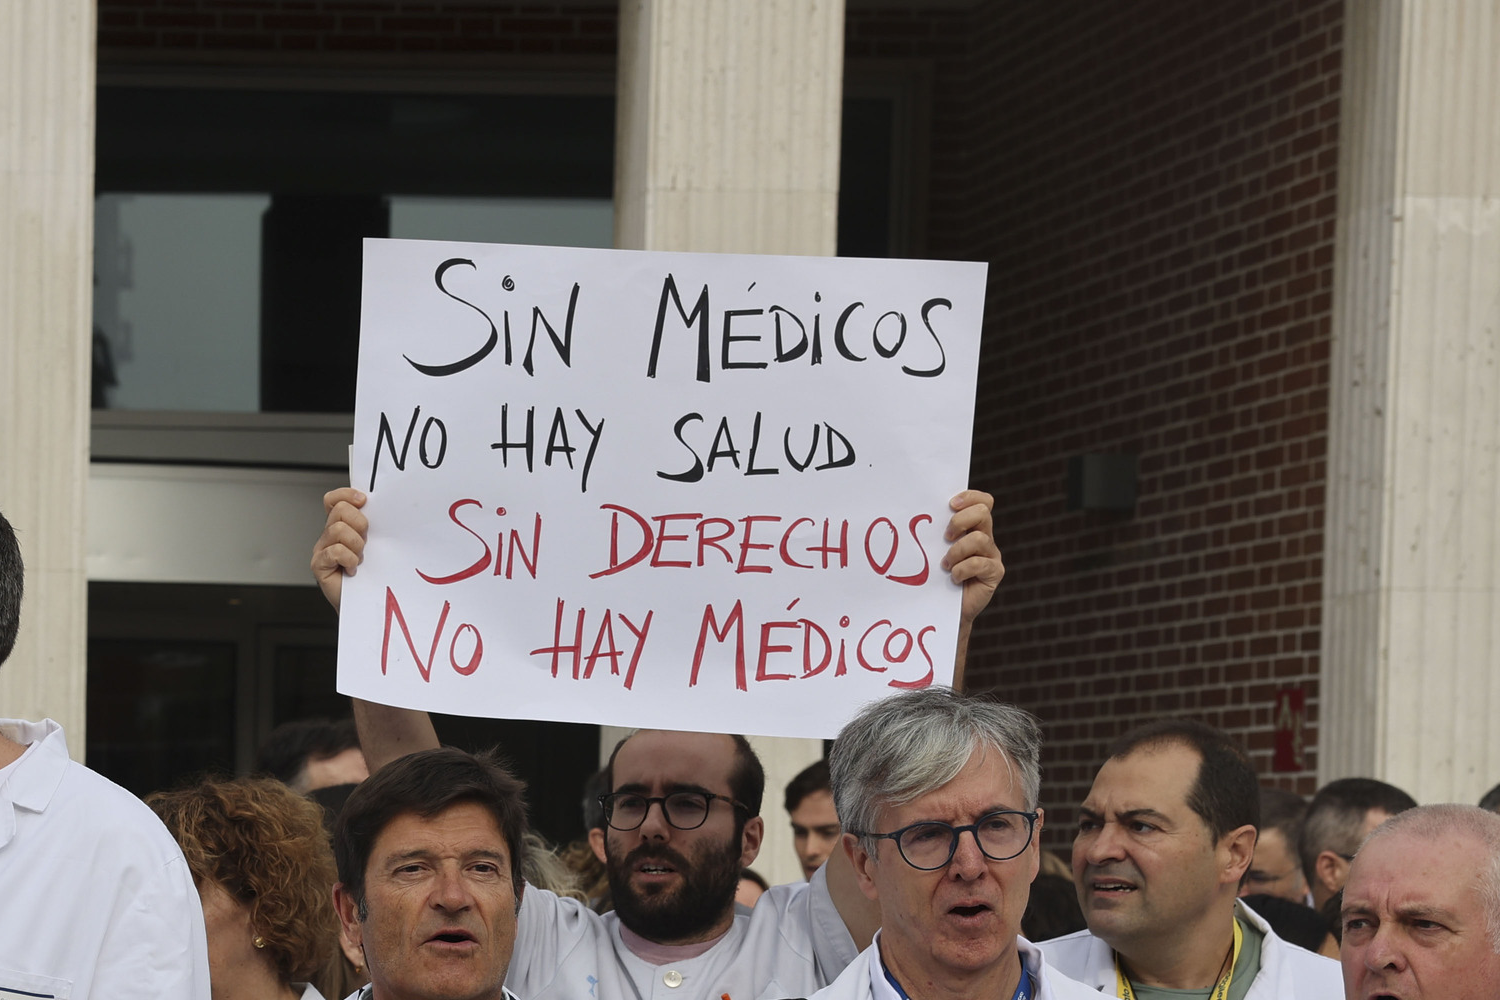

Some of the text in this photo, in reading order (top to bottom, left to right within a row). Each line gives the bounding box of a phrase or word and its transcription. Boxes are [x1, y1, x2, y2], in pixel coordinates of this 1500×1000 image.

[370, 406, 447, 492] NO
[491, 403, 604, 493] HAY
[590, 504, 932, 585] DERECHOS
[531, 599, 653, 689] HAY
